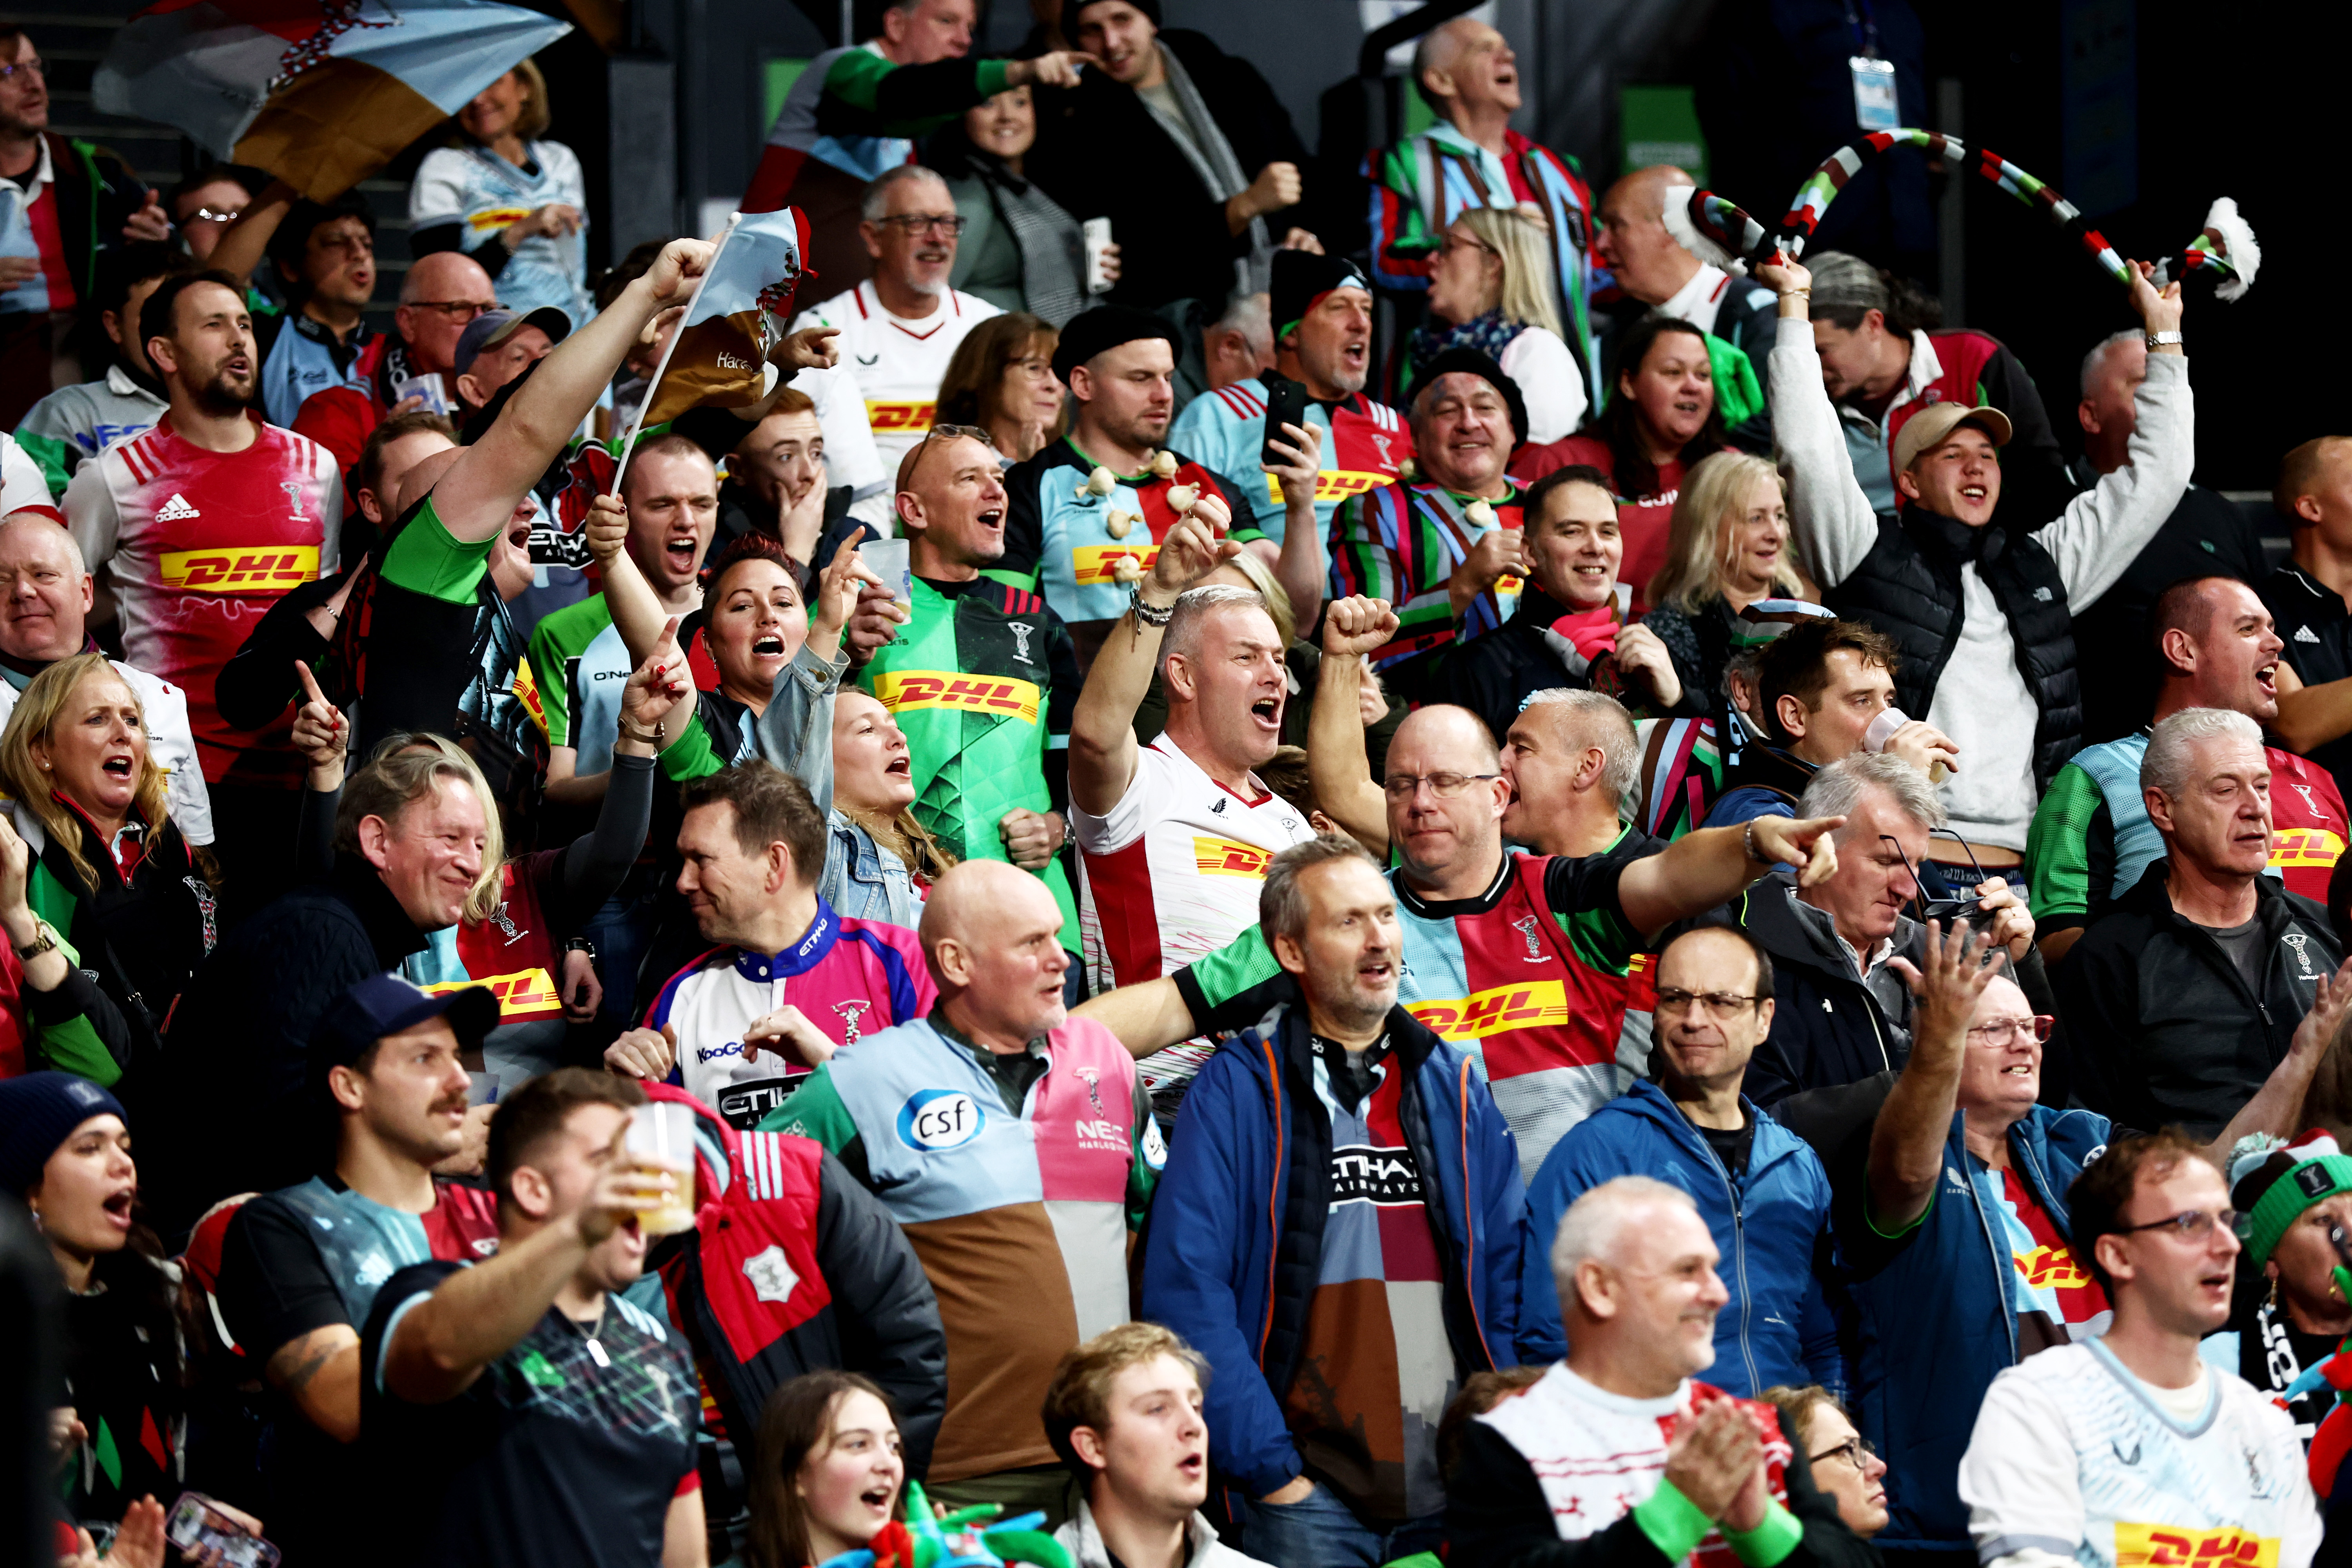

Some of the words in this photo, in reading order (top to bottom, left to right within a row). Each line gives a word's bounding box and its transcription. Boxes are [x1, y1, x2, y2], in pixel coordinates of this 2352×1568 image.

[155, 509, 200, 523] adidas
[184, 555, 305, 585] DHL
[899, 679, 1022, 709] DHL
[504, 930, 529, 946] Harlequins
[1412, 991, 1542, 1035] DHL
[919, 1100, 965, 1138] csf
[1076, 1120, 1127, 1145] NEC
[1334, 1179, 1420, 1194] AIRWAYS
[2148, 1532, 2263, 1568] DHL
